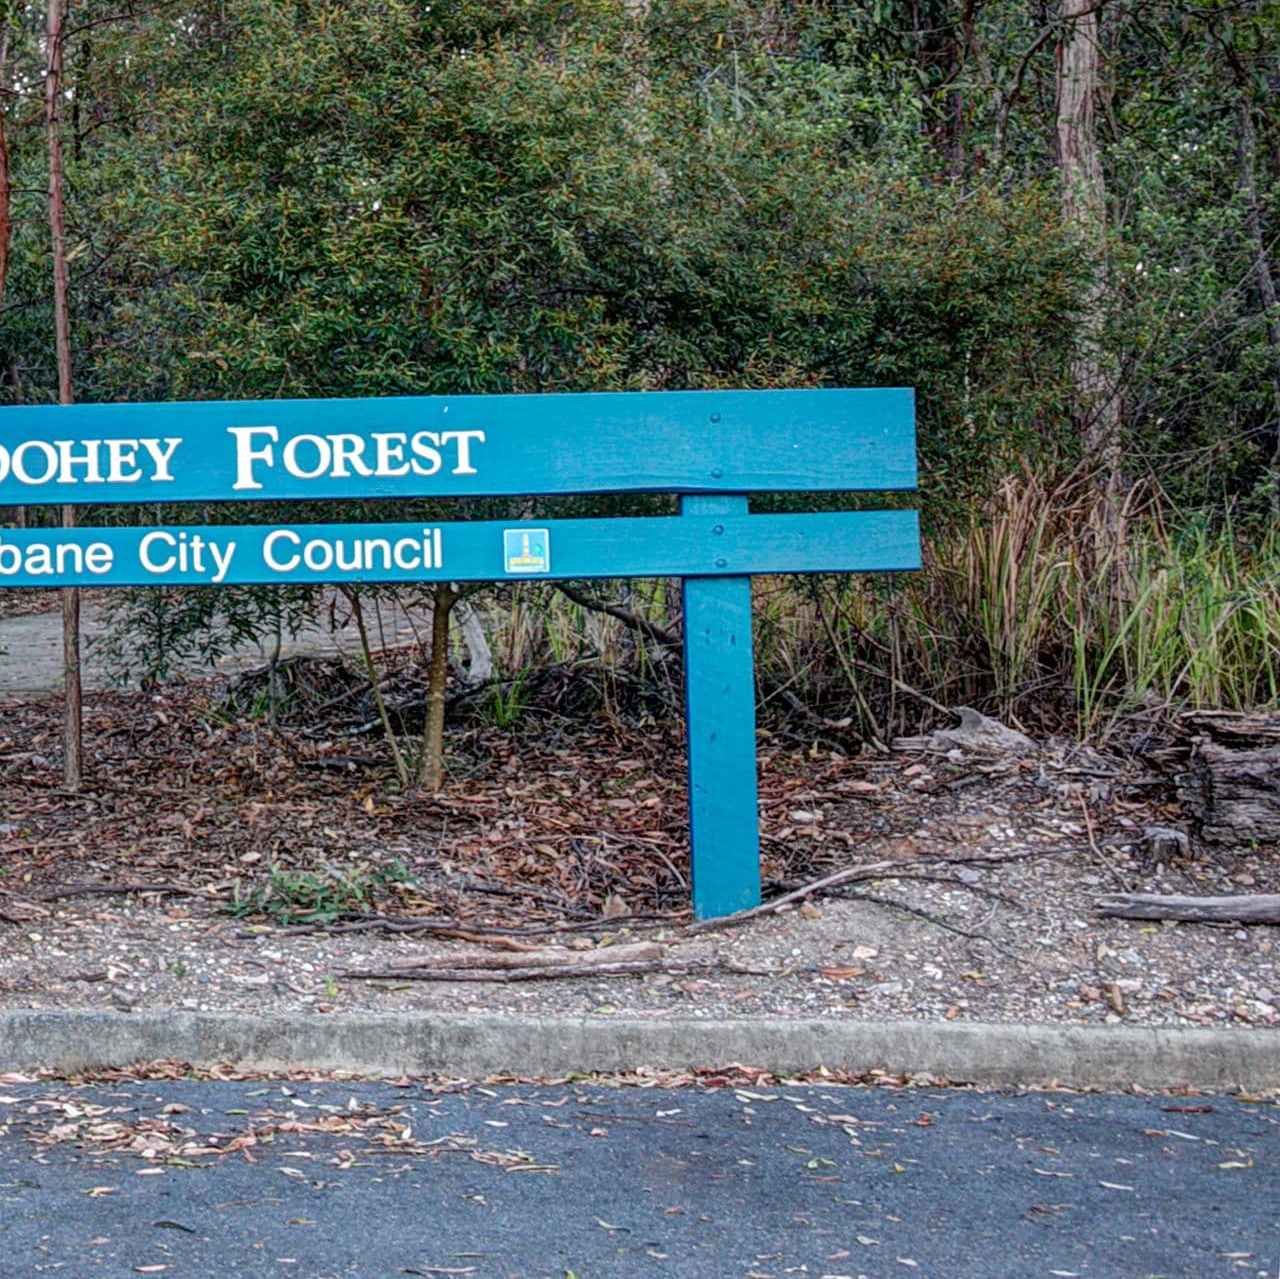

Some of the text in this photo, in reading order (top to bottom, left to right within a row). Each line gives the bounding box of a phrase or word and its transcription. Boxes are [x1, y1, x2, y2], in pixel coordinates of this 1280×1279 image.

[226, 425, 486, 490] FOREST
[139, 531, 236, 583] City
[263, 528, 442, 572] Council
